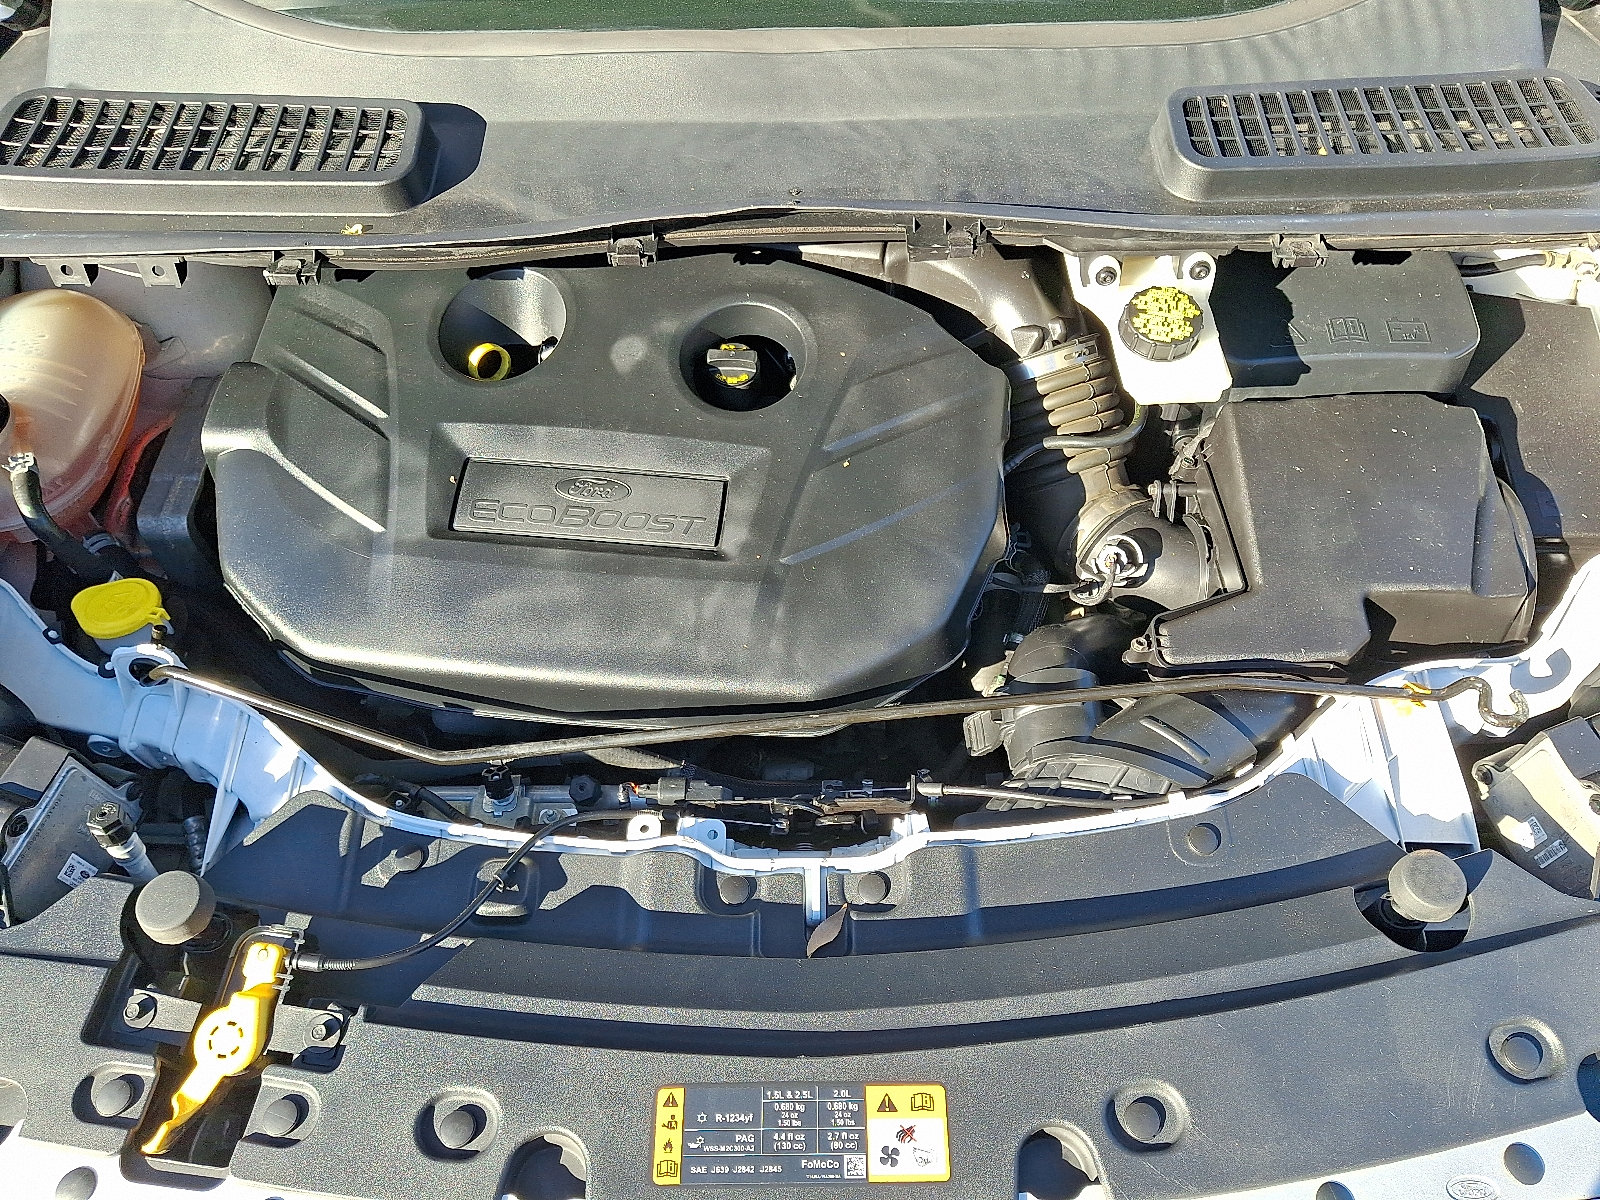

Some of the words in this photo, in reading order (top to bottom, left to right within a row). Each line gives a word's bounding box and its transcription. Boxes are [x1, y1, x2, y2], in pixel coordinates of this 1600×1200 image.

[568, 477, 621, 499] Ford
[468, 498, 707, 536] ECOBOOST
[786, 1091, 793, 1099] &
[794, 1090, 813, 1099] 2.5L
[833, 1090, 852, 1098] 2.0L
[795, 1102, 805, 1112] kg
[848, 1102, 858, 1111] kg
[715, 1113, 754, 1123] R-1234yf
[735, 1134, 755, 1143] PAG
[773, 1132, 786, 1140] 4.4
[827, 1132, 840, 1140] 2.7
[849, 1132, 860, 1140] oz
[773, 1141, 792, 1151] (130
[793, 1141, 806, 1151] cc)
[845, 1141, 858, 1150] cc)
[801, 1159, 840, 1169] FoMoCo
[690, 1166, 708, 1174] SAE
[710, 1165, 730, 1173] J639
[732, 1165, 755, 1173] J2842
[759, 1165, 783, 1173] J2845
